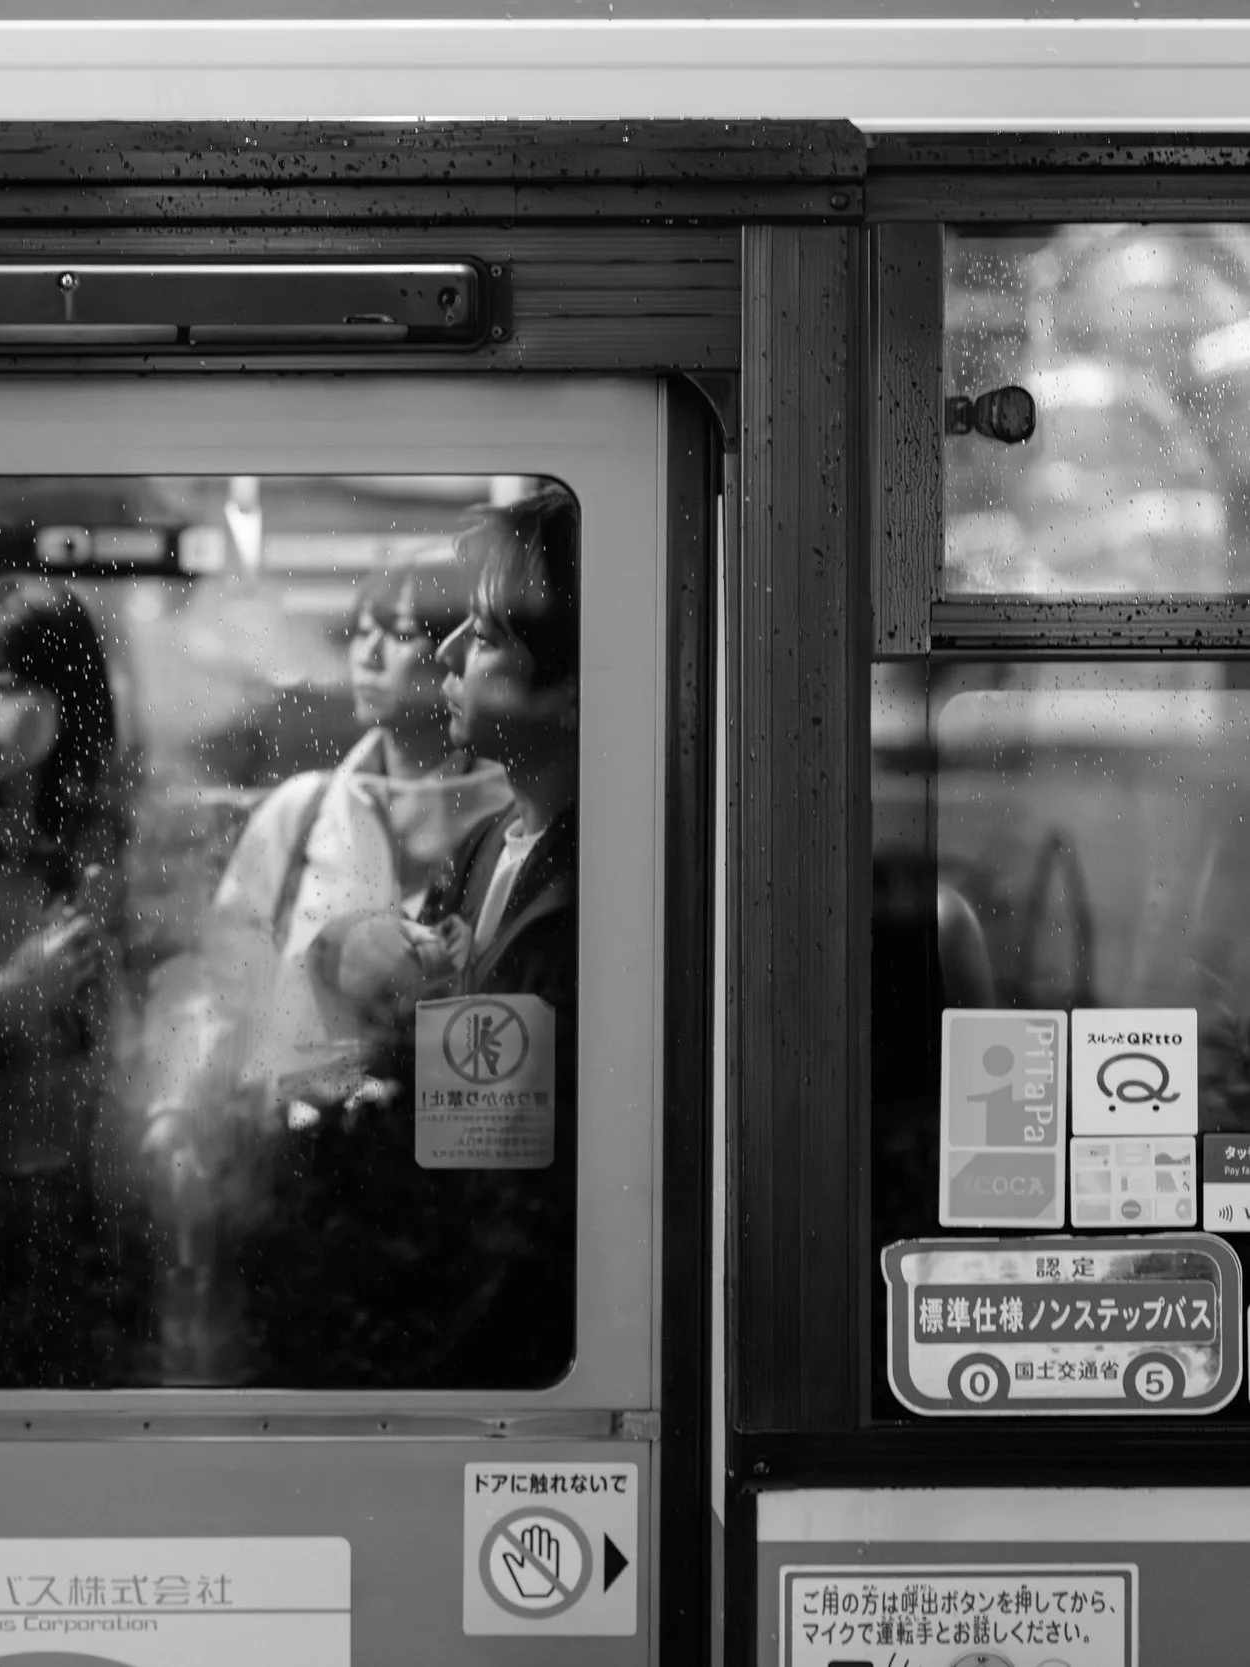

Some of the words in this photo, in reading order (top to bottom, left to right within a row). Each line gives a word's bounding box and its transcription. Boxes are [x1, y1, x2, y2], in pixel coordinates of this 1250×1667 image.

[1127, 1032, 1183, 1045] QRtto
[1024, 1023, 1054, 1142] PiTaPa
[1225, 1145, 1250, 1160] タッ
[963, 1176, 1045, 1196] ICOCA
[1036, 1257, 1095, 1279] 認定
[919, 1295, 1212, 1333] 標準仕様ノンステップバス
[1015, 1361, 1120, 1381] 国土交通省
[969, 1371, 991, 1396] 0
[1145, 1370, 1165, 1395] 5
[475, 1473, 627, 1494] ドアに触れないで
[23, 1615, 159, 1634] Corporation
